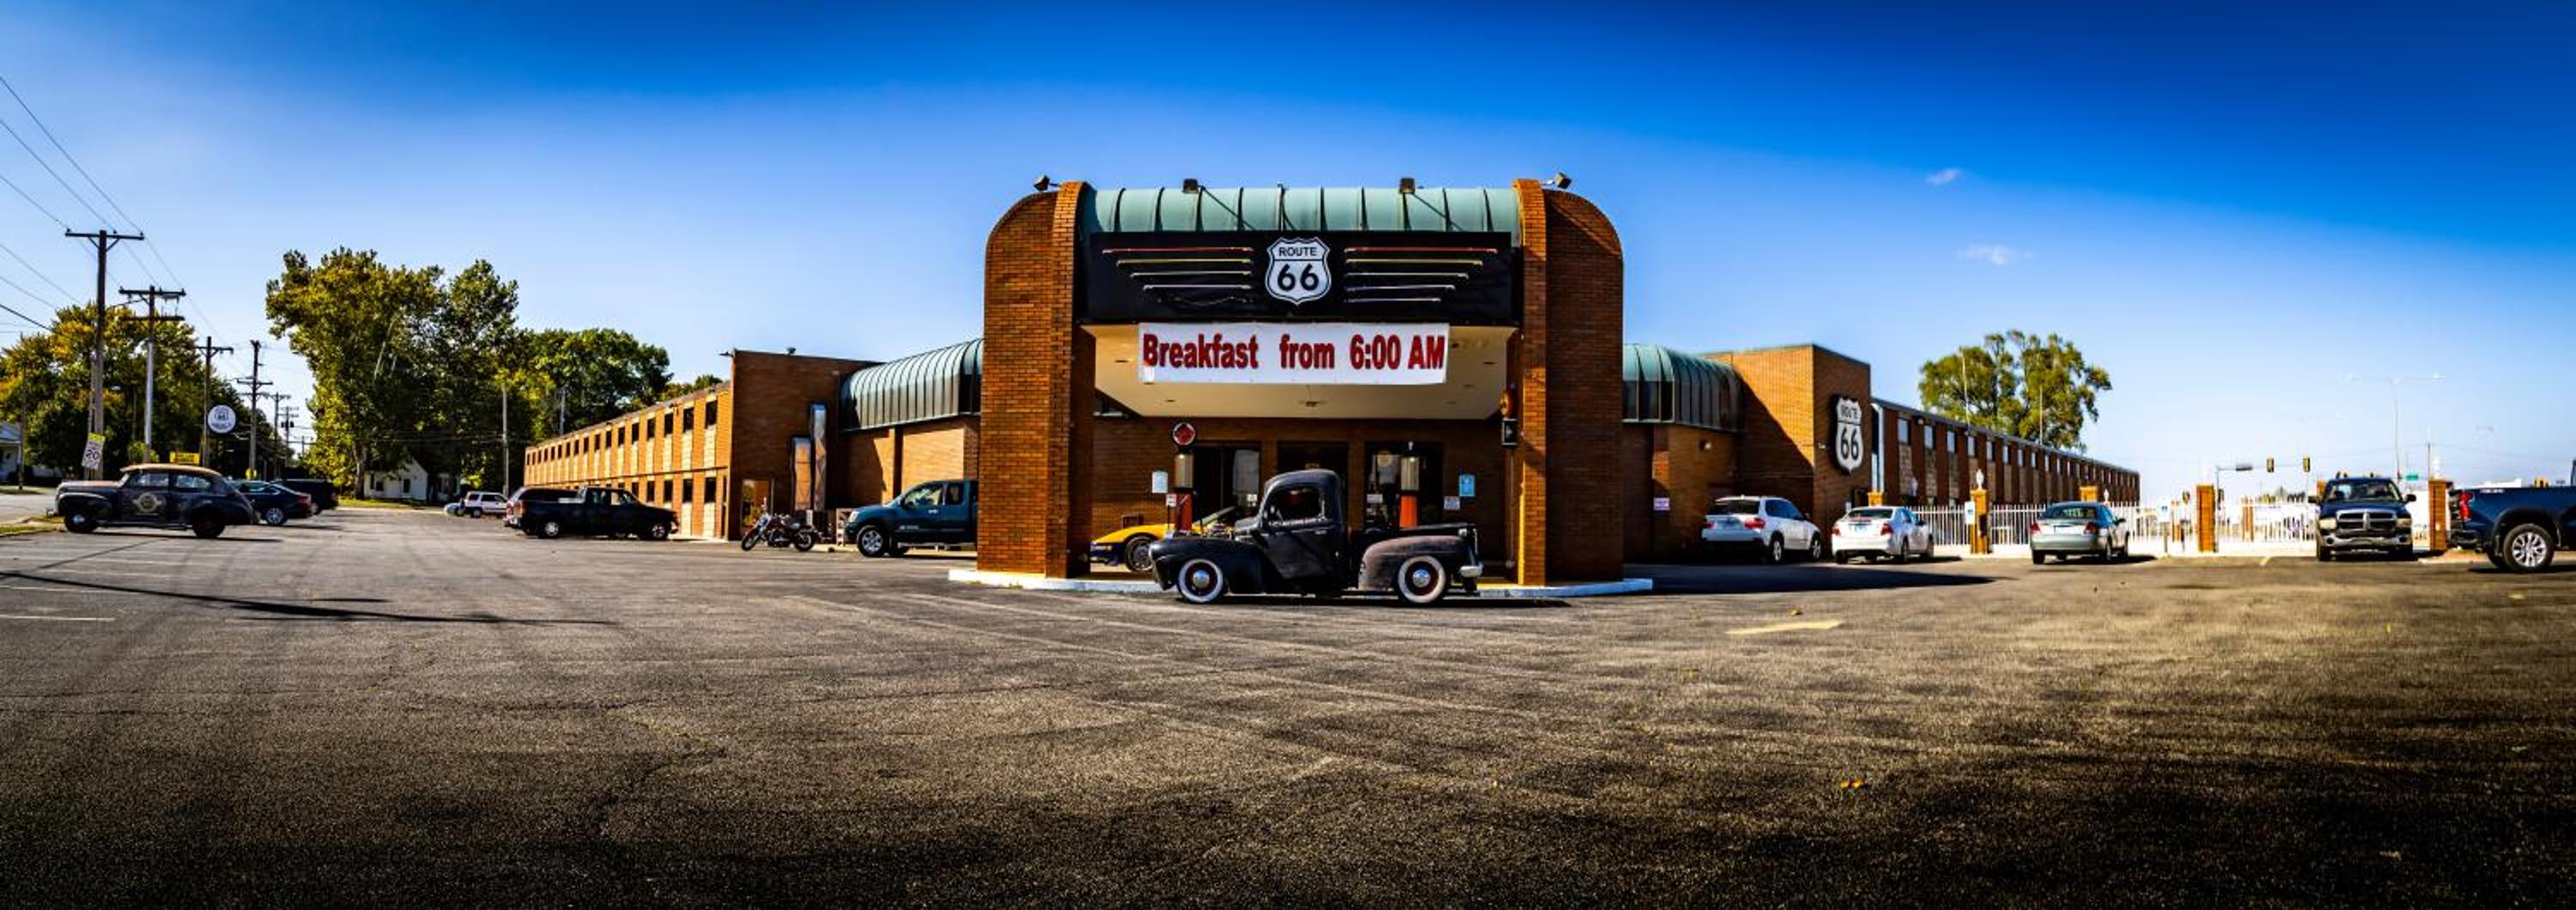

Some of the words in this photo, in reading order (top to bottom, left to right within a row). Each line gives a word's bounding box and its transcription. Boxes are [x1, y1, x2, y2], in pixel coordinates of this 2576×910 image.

[1279, 246, 1318, 257] ROUTE
[1277, 263, 1320, 292] 66
[1143, 333, 1259, 369] Breakfast
[1279, 333, 1335, 369] from
[1350, 334, 1401, 370] 6:00
[1407, 335, 1445, 370] AM
[86, 449, 100, 460] 20
[1840, 426, 1859, 460] 66
